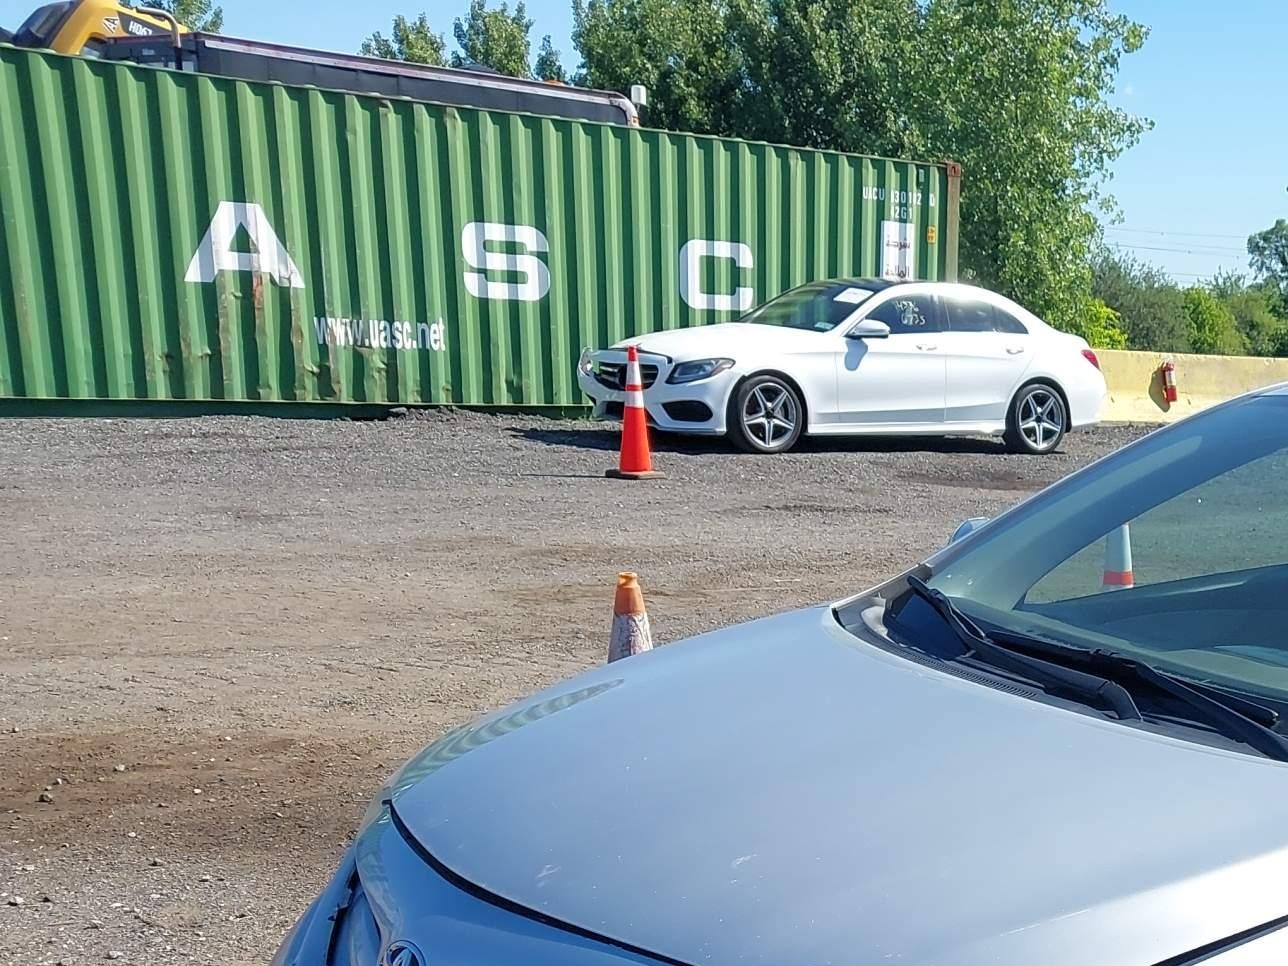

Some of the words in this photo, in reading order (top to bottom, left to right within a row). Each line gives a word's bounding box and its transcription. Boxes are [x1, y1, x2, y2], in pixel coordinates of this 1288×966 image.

[184, 200, 305, 288] A
[461, 221, 551, 302] S
[679, 239, 754, 311] C
[313, 317, 446, 351] www.uasc.net
